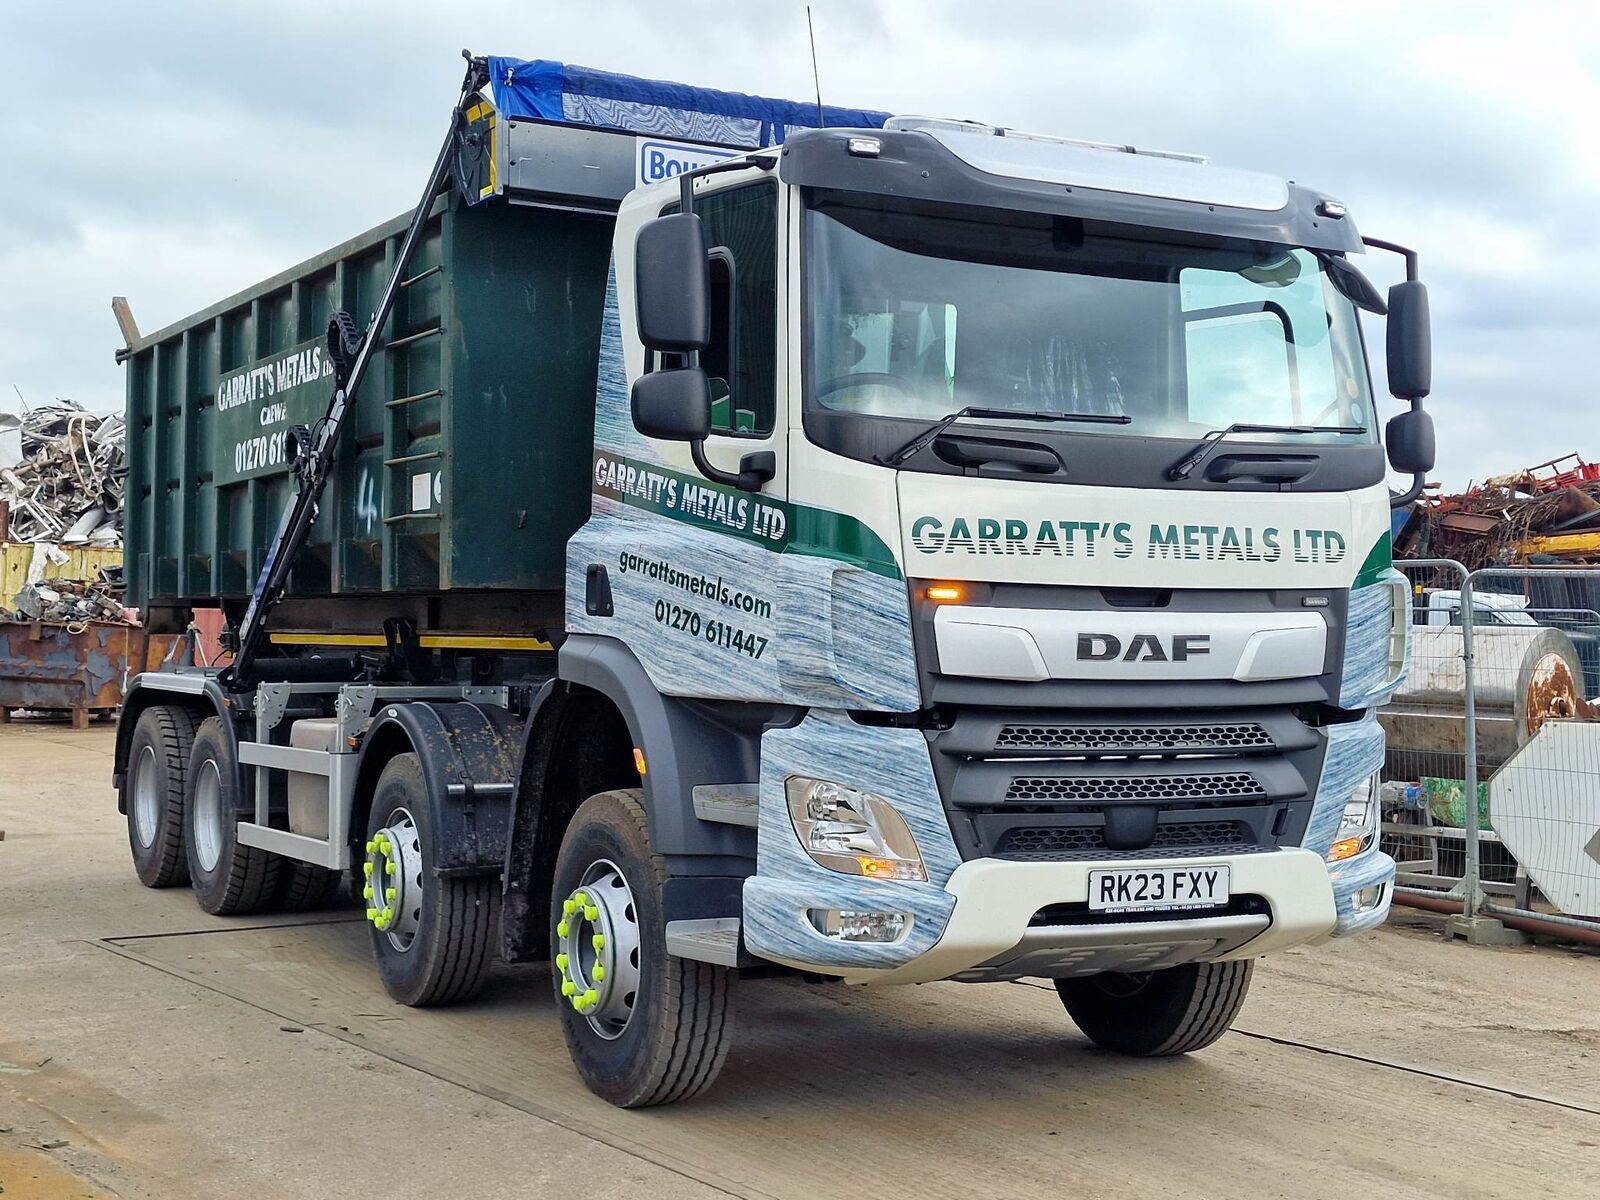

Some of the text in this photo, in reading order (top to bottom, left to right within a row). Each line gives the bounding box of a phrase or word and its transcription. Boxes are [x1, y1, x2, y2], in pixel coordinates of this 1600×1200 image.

[217, 363, 274, 411] GARRATT'S
[276, 346, 321, 393] METALS
[235, 435, 267, 473] 01270
[595, 457, 786, 540] GARRATT'S METALS LTD
[911, 515, 1346, 564] GARRATT'S METALS LTD
[619, 551, 771, 618] garrattsmetals.com
[655, 599, 769, 660] 01270 611447
[1076, 632, 1210, 663] DAF
[1100, 870, 1218, 903] RK23 FXY
